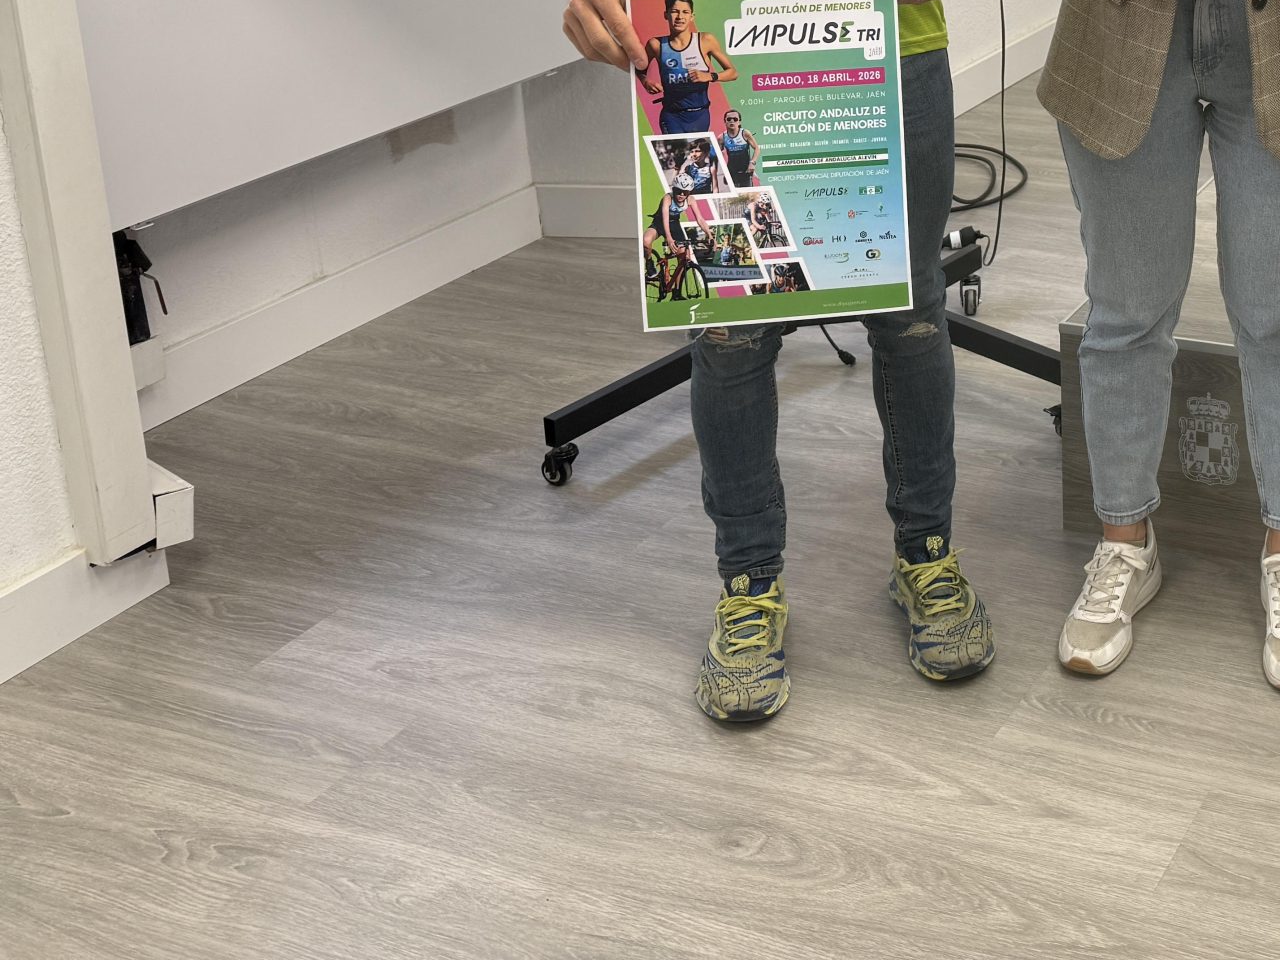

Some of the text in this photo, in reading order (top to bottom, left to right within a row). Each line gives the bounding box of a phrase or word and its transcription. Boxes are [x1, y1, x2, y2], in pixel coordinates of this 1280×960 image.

[746, 1, 872, 16] IV DUATLÓN DE MENORES
[728, 21, 881, 49] IMPULSE TRI
[757, 71, 881, 87] SÁBADO, 18 ABRIL, 2026
[740, 98, 764, 107] 9.00H
[809, 94, 824, 102] DEL
[866, 90, 886, 98] JAÉN
[763, 106, 886, 122] CIRCUITO ANDALUZ DE
[763, 119, 887, 136] DUATLÓN DE MENORES
[777, 158, 816, 166] CAMPEONATO
[768, 174, 795, 183] CIRCUITO
[796, 173, 829, 181] PROVINCIAL
